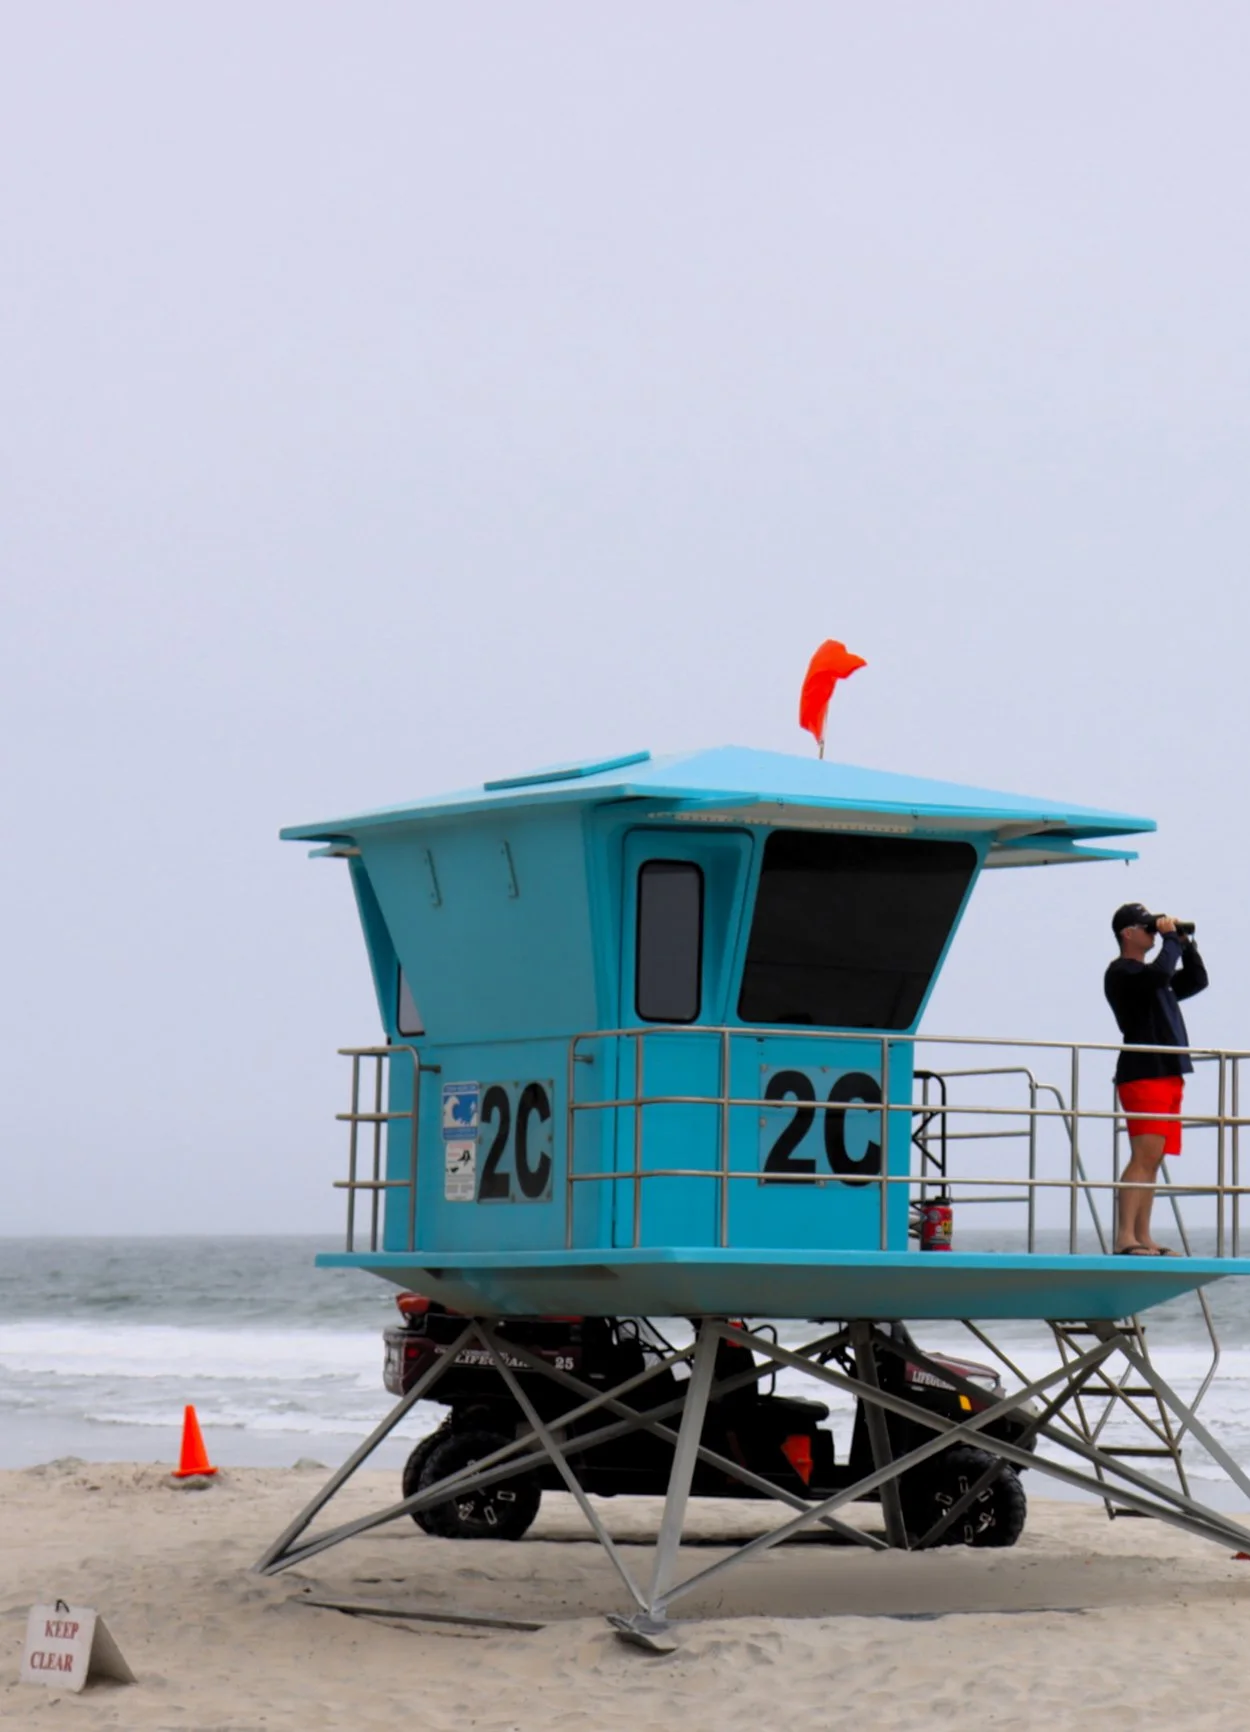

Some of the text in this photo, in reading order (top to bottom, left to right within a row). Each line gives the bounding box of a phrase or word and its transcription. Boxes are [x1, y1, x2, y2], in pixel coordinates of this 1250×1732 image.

[763, 1070, 883, 1187] 2C
[478, 1082, 552, 1199] 2C
[555, 1356, 574, 1370] 25
[45, 1620, 79, 1639] KEEP
[30, 1651, 73, 1672] CLEAR
